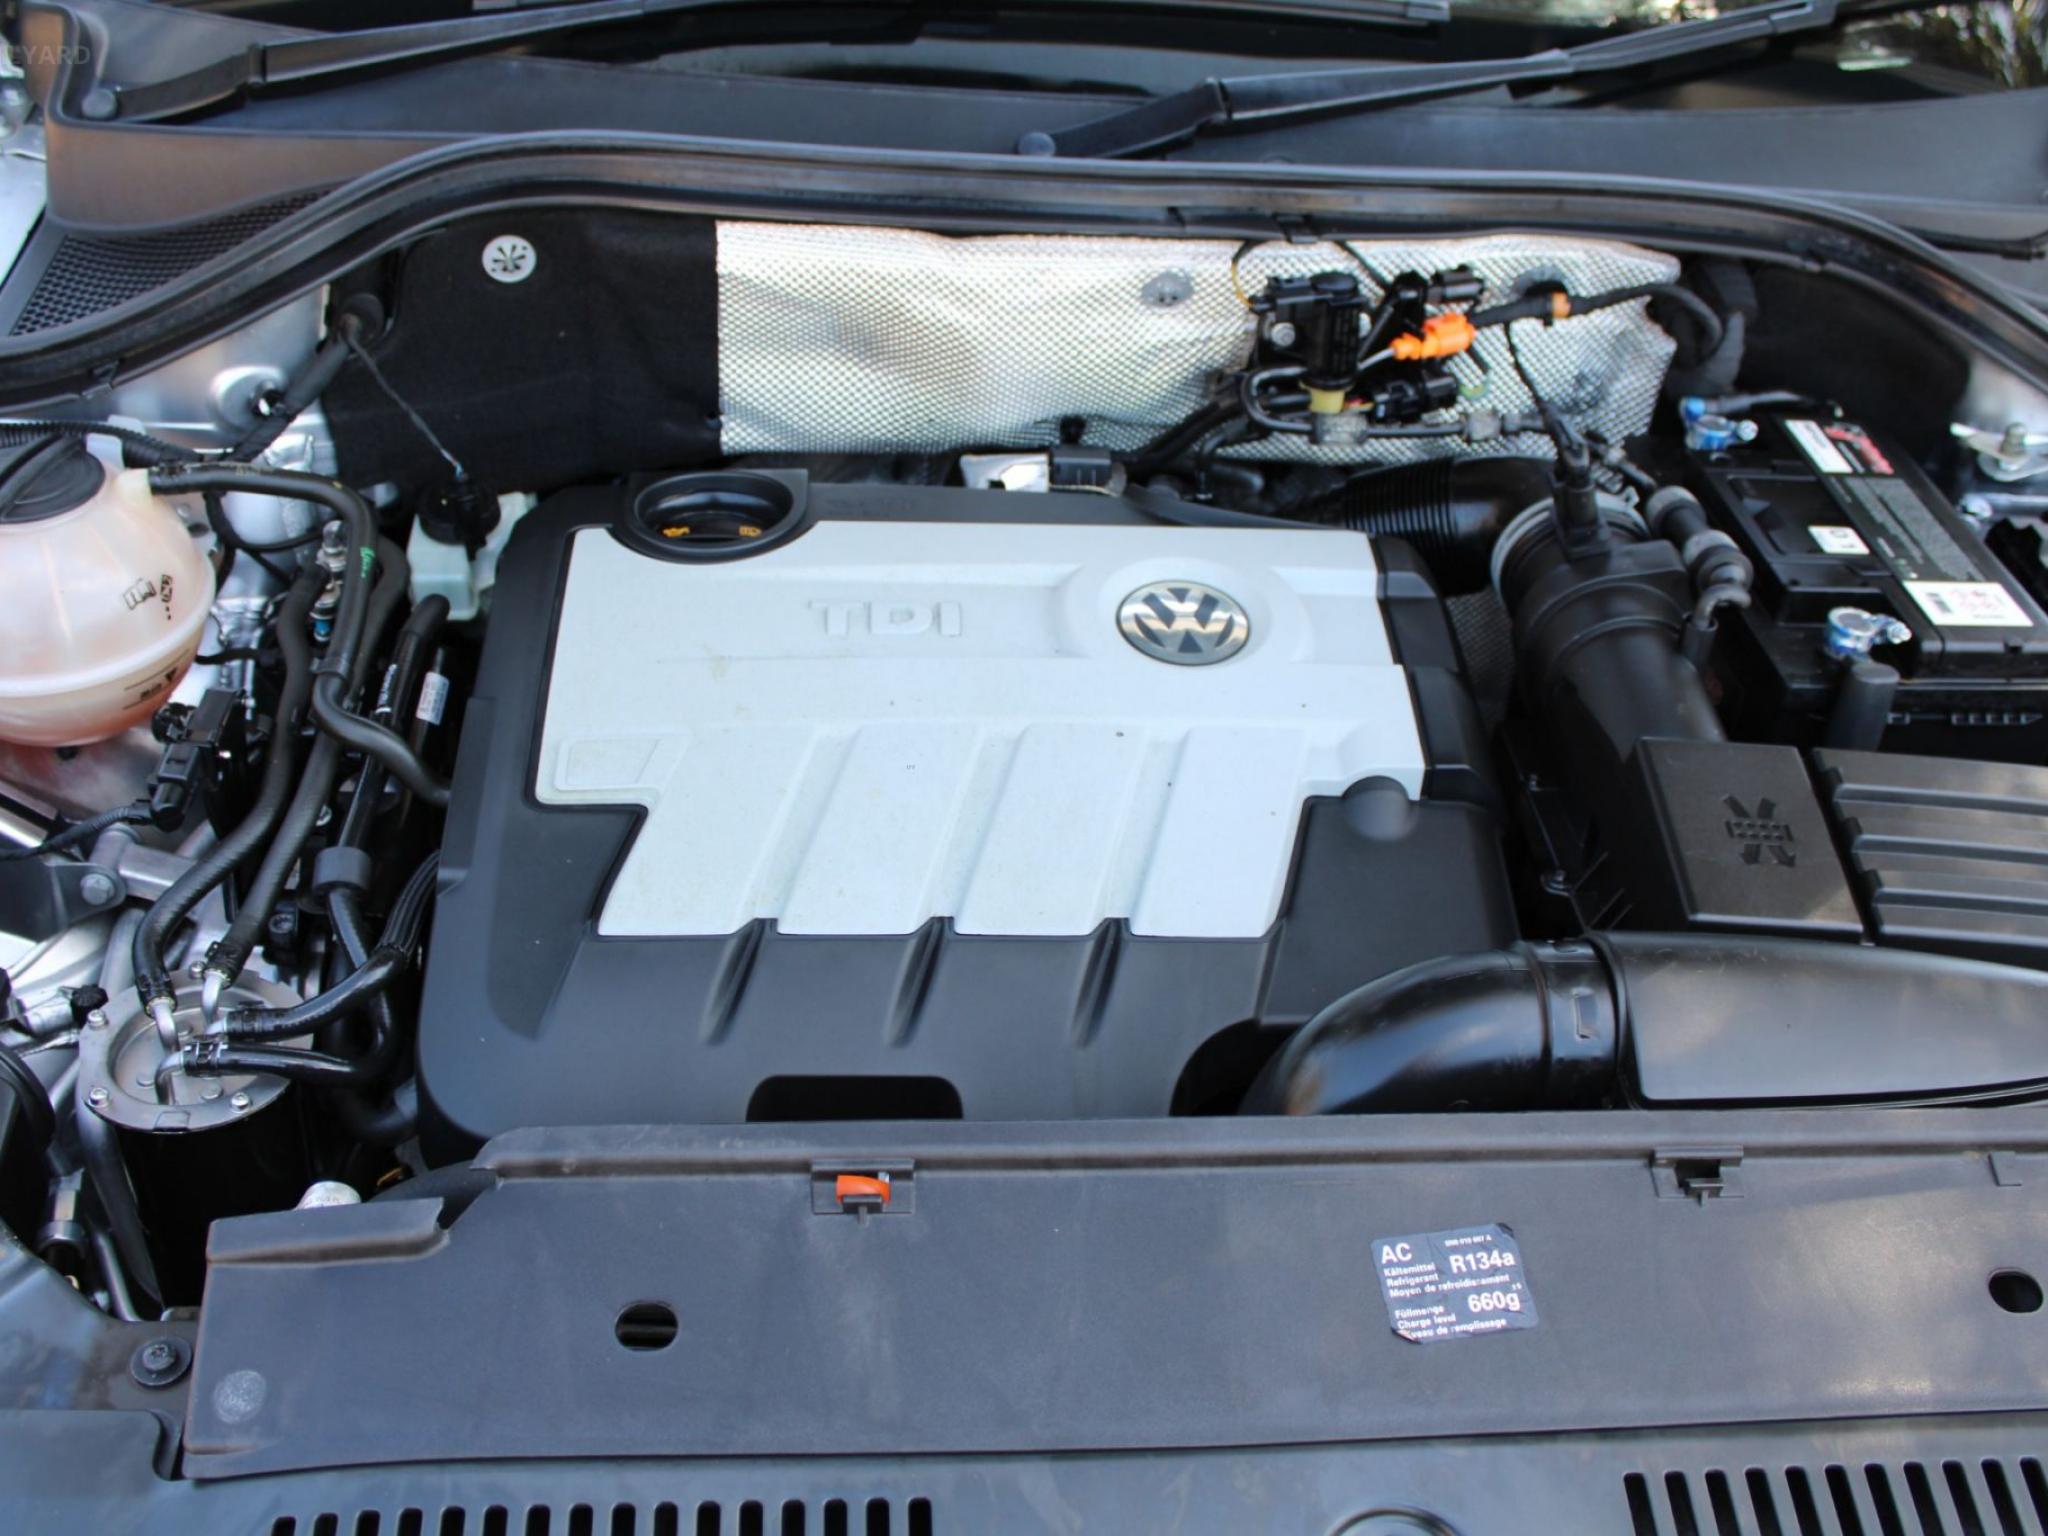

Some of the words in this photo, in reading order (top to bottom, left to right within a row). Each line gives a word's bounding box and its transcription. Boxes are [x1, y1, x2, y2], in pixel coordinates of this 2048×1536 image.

[808, 600, 963, 638] TDI
[1381, 1243, 1412, 1264] AC
[1449, 1248, 1516, 1274] R134a
[1386, 1273, 1439, 1287] Refrigerant
[1388, 1286, 1421, 1298] Moyen
[1424, 1284, 1437, 1293] de
[1467, 1290, 1521, 1313] 660g
[1394, 1305, 1445, 1319] Füllmenge
[1397, 1318, 1432, 1330] Charge
[1433, 1312, 1457, 1324] level
[1436, 1325, 1449, 1336] de
